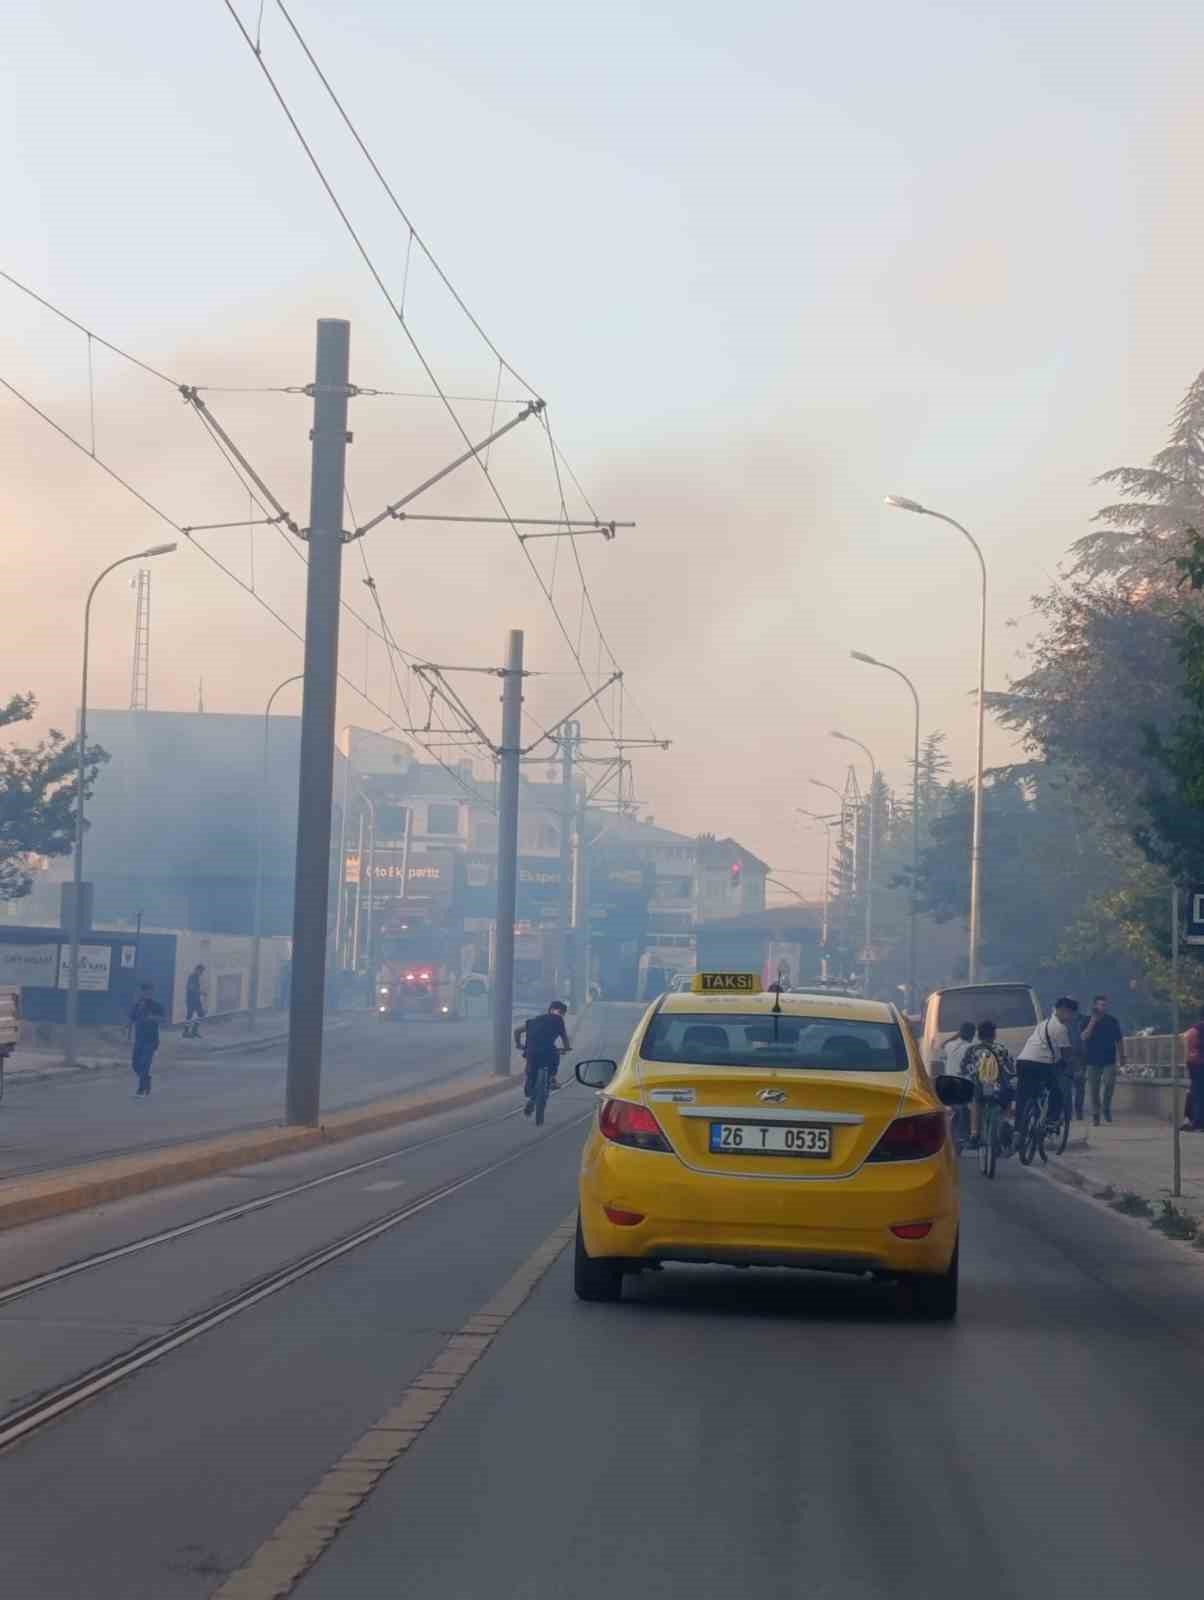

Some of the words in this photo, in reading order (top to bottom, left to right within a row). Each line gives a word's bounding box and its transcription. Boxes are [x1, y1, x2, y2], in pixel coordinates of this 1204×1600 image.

[722, 1126, 744, 1147] 26
[760, 1128, 769, 1148] T
[785, 1129, 828, 1151] 0535
